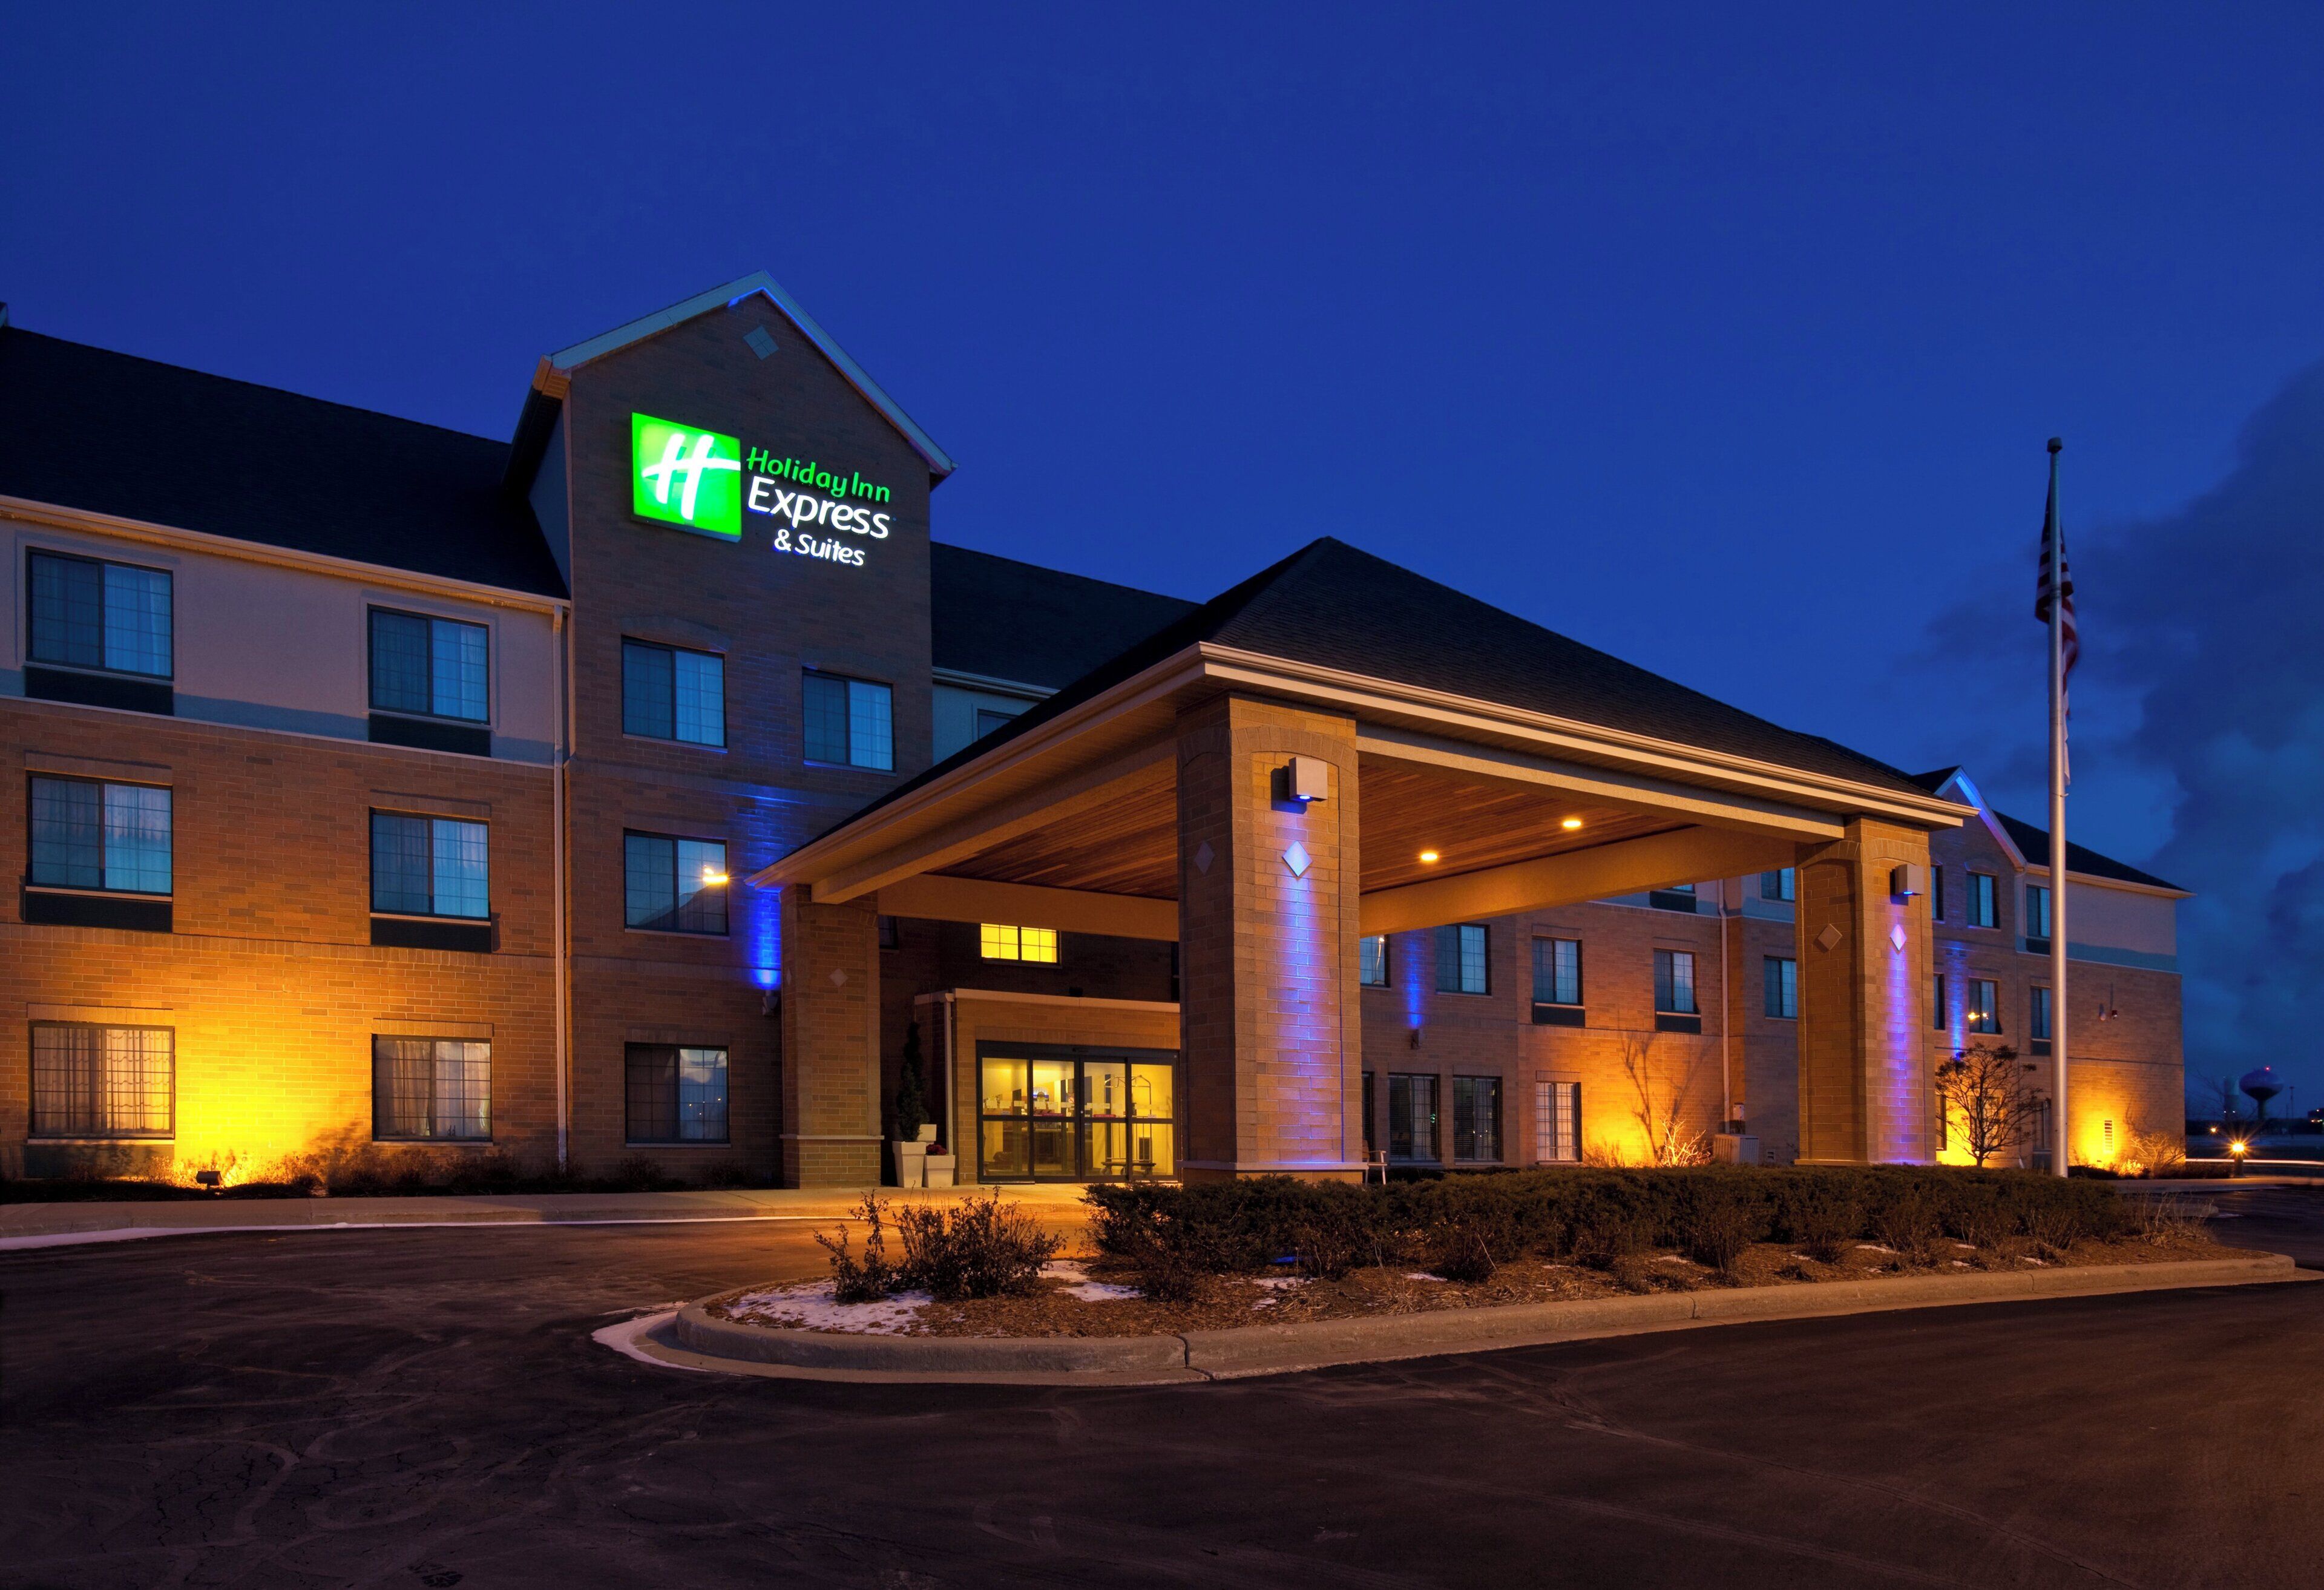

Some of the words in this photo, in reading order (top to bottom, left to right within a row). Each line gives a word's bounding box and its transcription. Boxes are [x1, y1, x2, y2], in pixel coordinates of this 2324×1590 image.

[746, 447, 847, 498] Holiday
[852, 471, 890, 503] Inn
[748, 476, 890, 539] Express
[774, 528, 792, 551] &
[795, 533, 865, 566] Suites
